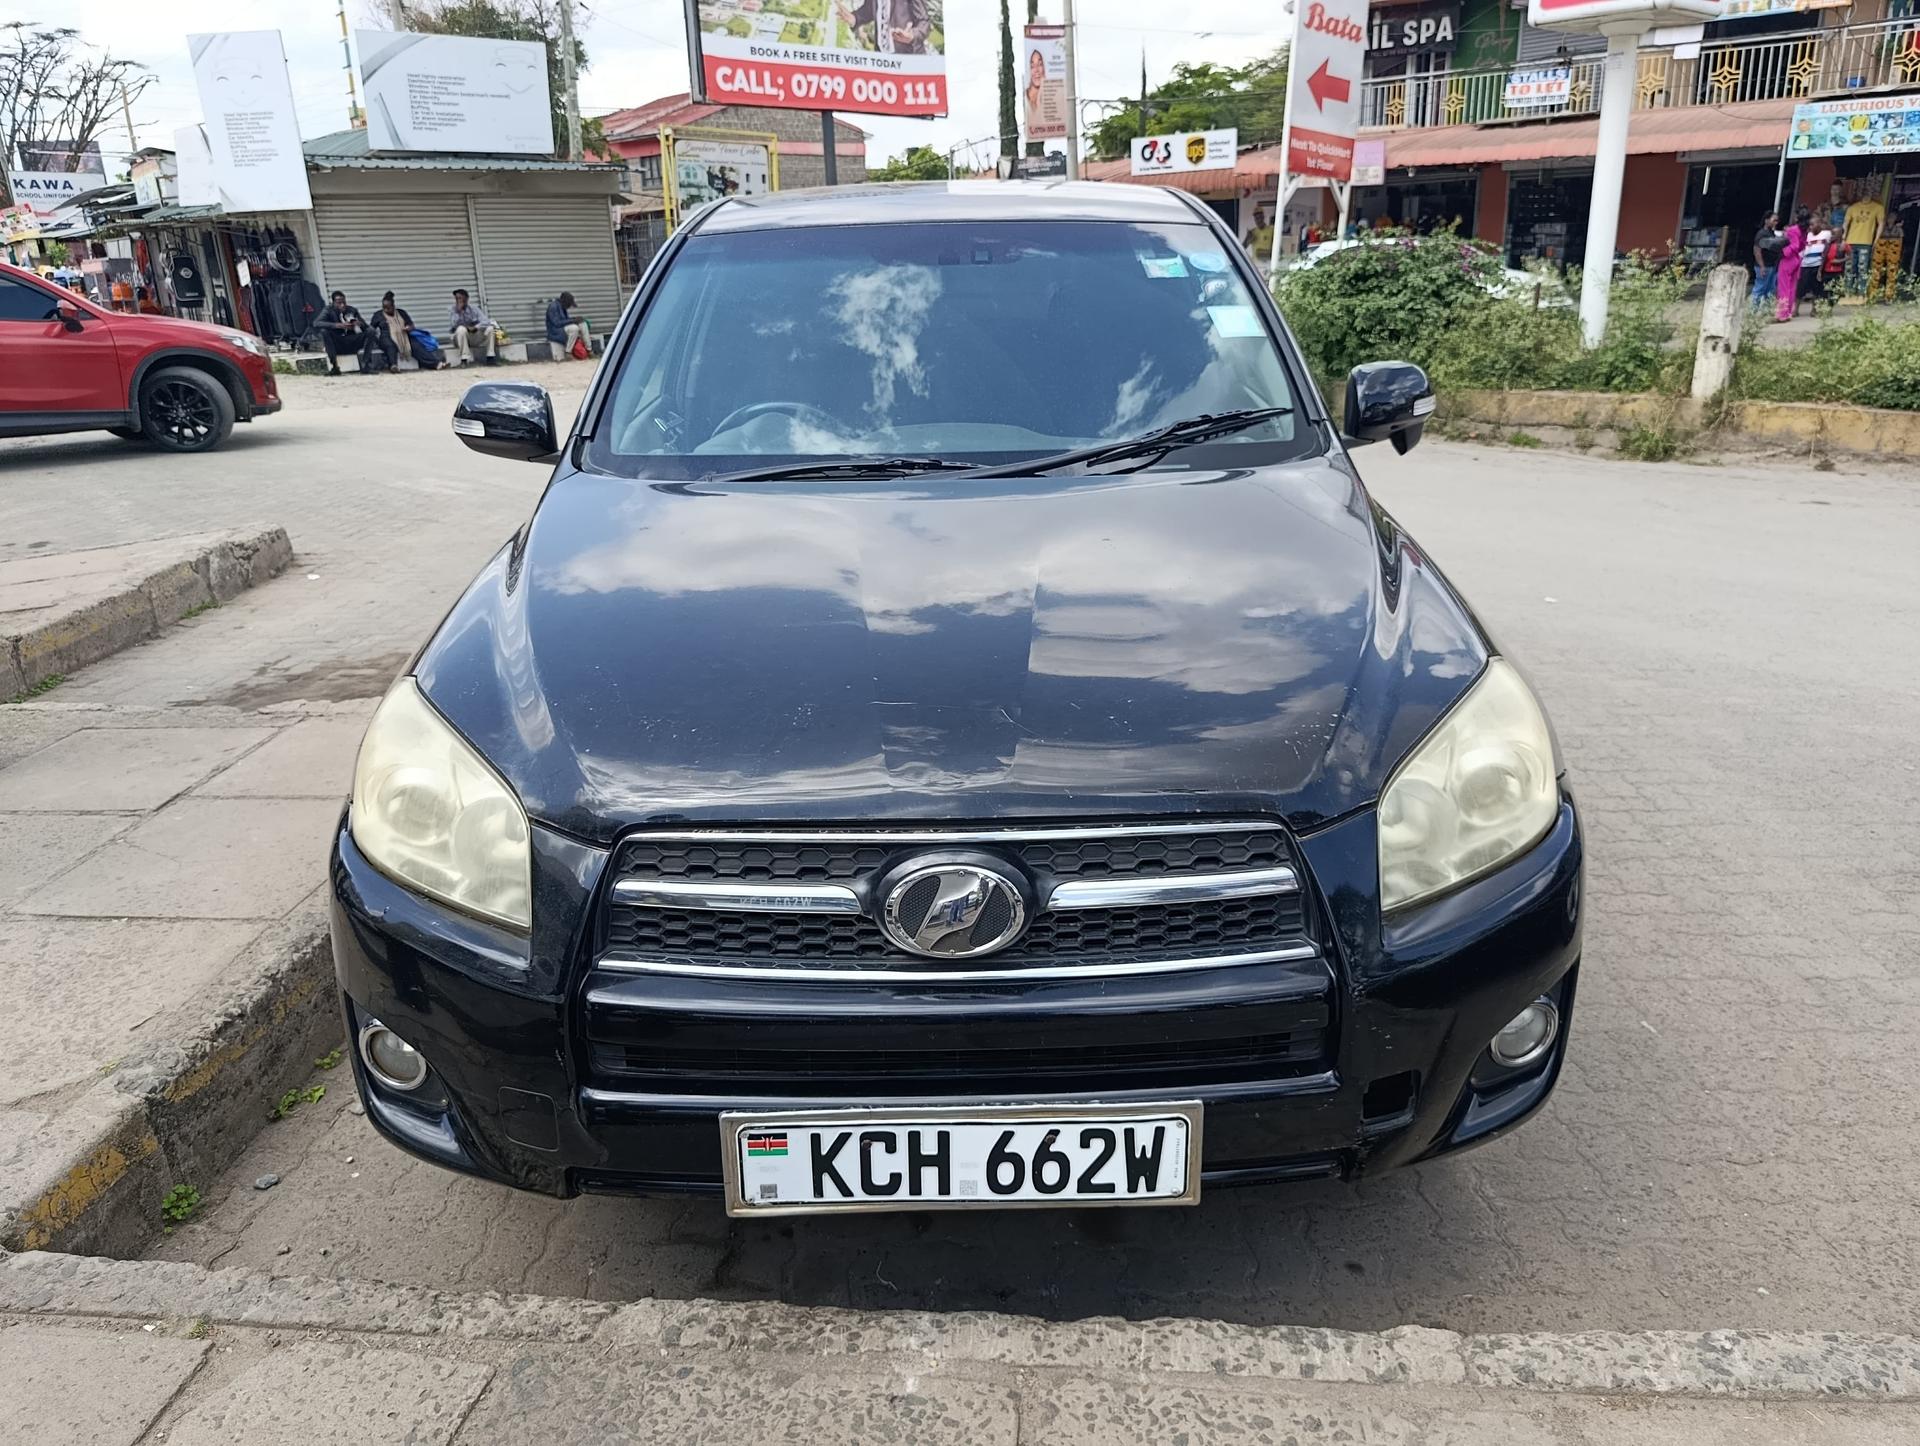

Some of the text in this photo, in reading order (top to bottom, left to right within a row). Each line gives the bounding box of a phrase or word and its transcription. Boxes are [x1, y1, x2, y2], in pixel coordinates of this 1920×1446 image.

[1304, 2, 1362, 44] Bata
[1403, 16, 1453, 46] SPA
[750, 46, 902, 69] BOOK A FREE SITE VISIT TODAY
[715, 66, 939, 105] CALL; 0799 000 111
[1510, 68, 1567, 83] STALLS
[1510, 82, 1564, 96] TO LET
[1821, 99, 1904, 113] LUXURIOUS
[13, 179, 74, 191] KAWA
[810, 1130, 950, 1198] KCH
[986, 1126, 1166, 1194] 662W
